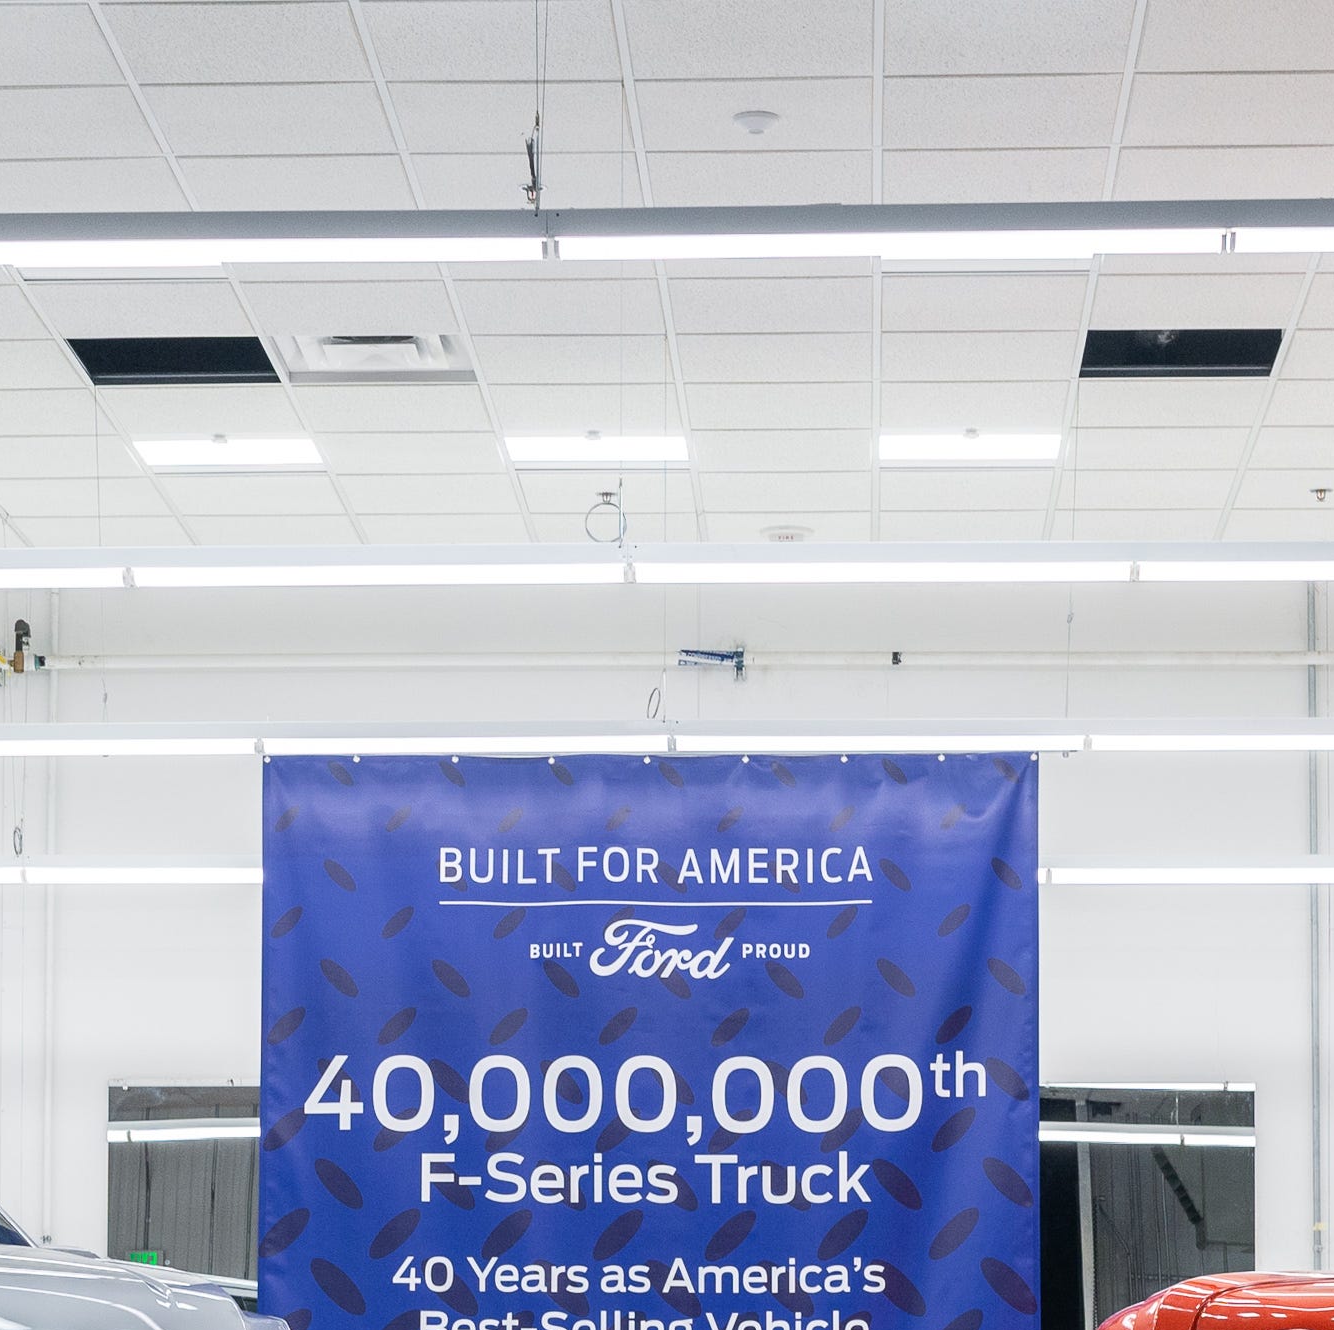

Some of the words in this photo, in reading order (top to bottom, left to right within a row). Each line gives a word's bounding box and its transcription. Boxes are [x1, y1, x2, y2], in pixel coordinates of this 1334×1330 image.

[439, 847, 561, 885] BUILT
[577, 846, 659, 884] FOR
[677, 845, 873, 884] AMERICA
[529, 942, 584, 959] BUILT
[589, 918, 735, 980] Ford
[742, 943, 811, 959] PROUD
[303, 1050, 987, 1146] 40,000,000th
[421, 1152, 679, 1204] F-Series
[694, 1150, 872, 1205] Truck
[392, 1255, 454, 1293] 40
[466, 1256, 589, 1294] Years
[600, 1264, 651, 1294] as
